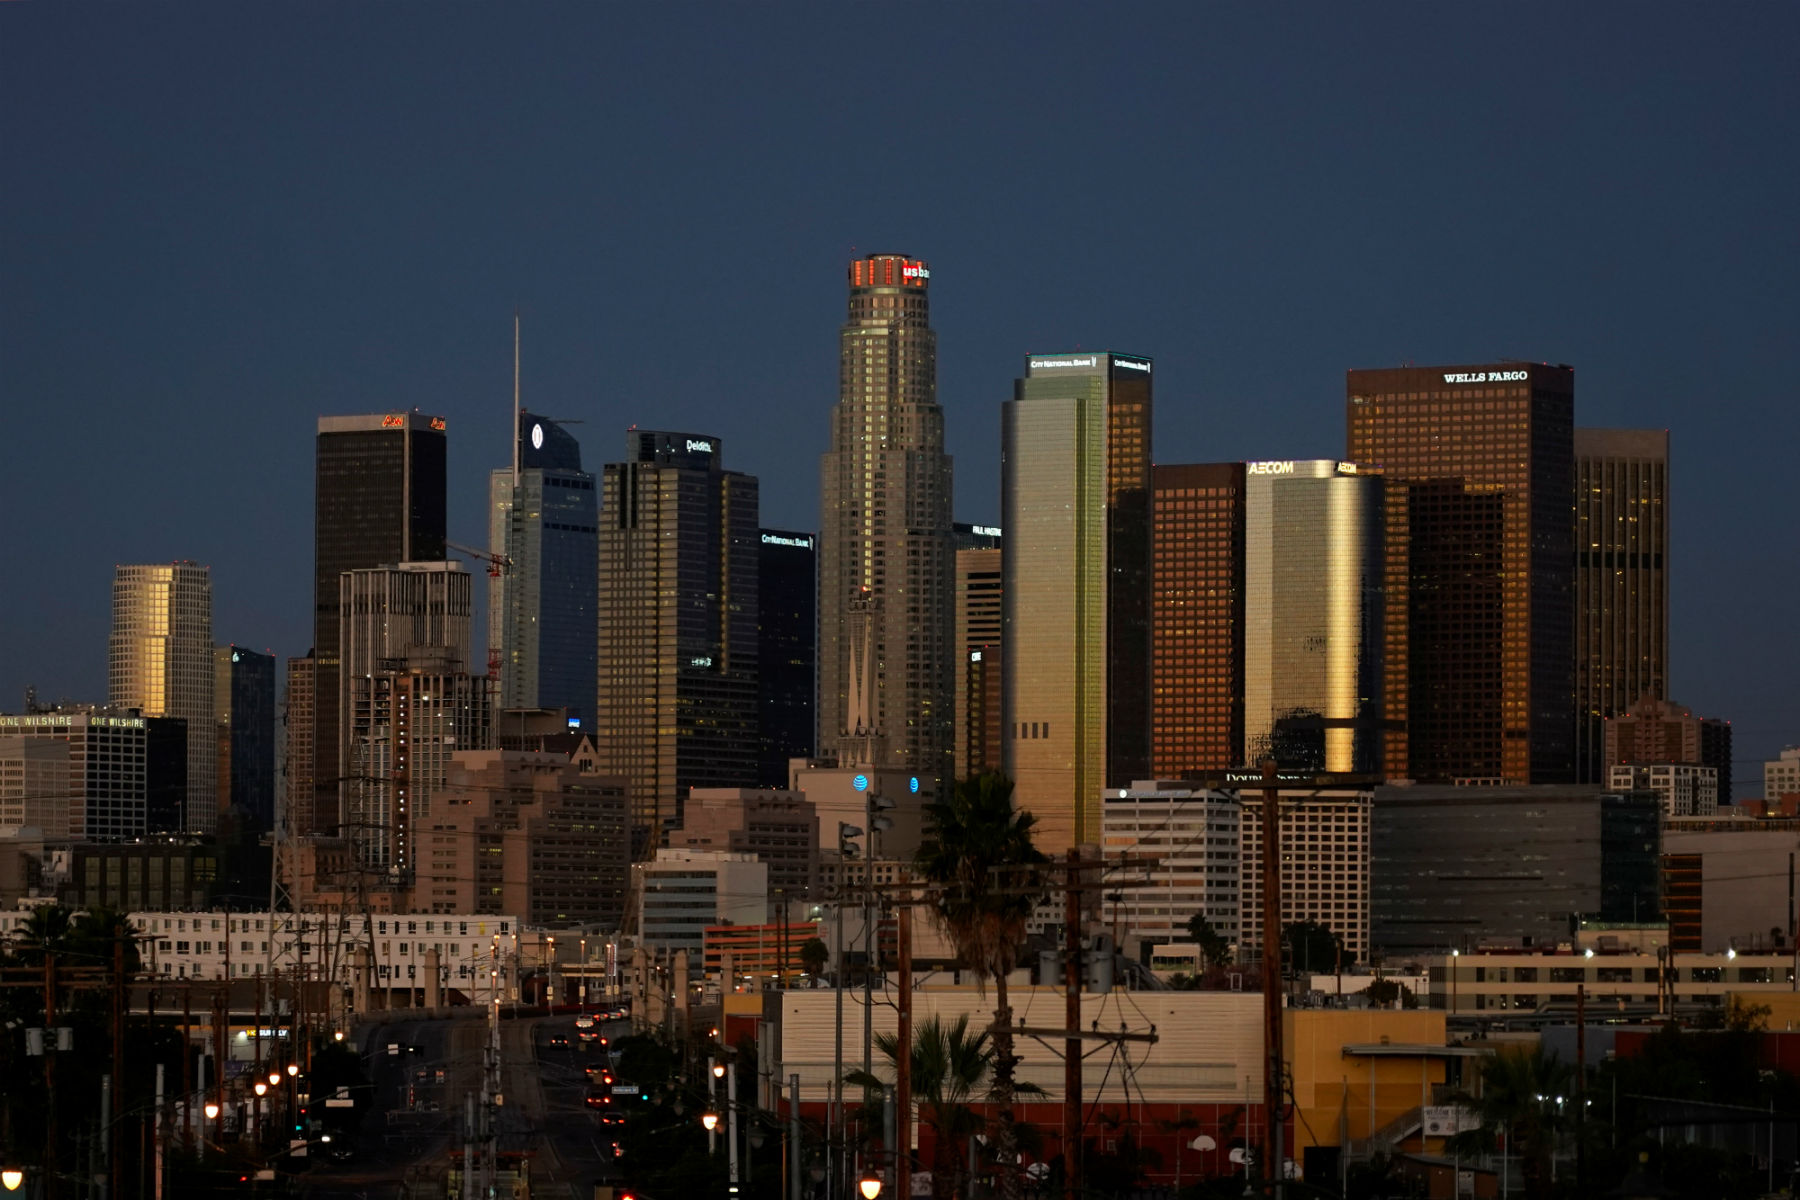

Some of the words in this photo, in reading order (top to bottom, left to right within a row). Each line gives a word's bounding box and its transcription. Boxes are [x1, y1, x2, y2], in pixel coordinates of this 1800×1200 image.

[1444, 373, 1486, 383] WELLS
[1488, 371, 1528, 382] FARGO
[1248, 461, 1294, 474] AECOM
[1338, 462, 1357, 473] AECOM
[0, 718, 19, 726] ONE
[25, 716, 72, 726] WILSHIRE
[91, 717, 106, 726] ONE
[109, 718, 144, 728] WILSHIRE
